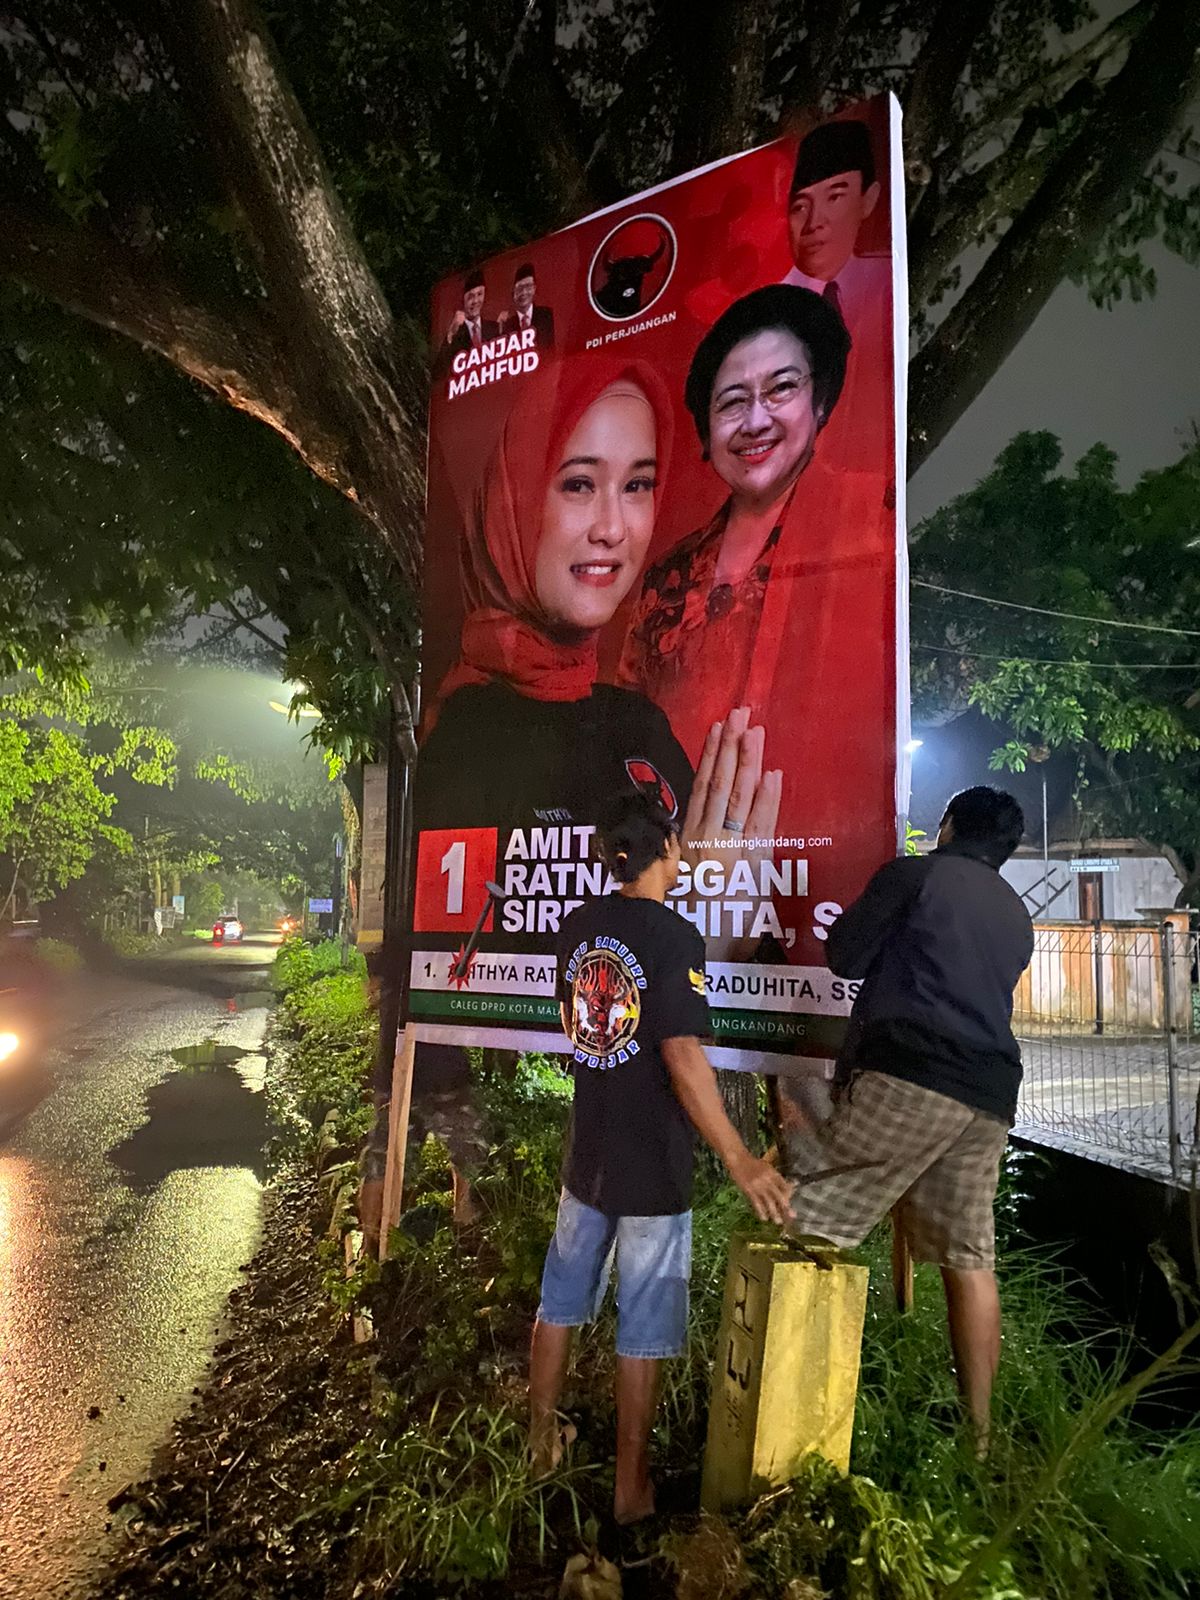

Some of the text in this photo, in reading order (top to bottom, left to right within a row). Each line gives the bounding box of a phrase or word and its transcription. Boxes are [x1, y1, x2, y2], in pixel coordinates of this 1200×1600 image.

[452, 327, 536, 374] GANJAR
[585, 311, 678, 350] PDI PERJUANGAN
[447, 352, 540, 400] MAHFUD
[688, 836, 832, 850] www.kedungkandang.com
[440, 842, 466, 914] 1
[664, 901, 796, 949] HITA,
[424, 962, 437, 978] 1.
[450, 1000, 478, 1011] CALEG
[481, 1001, 506, 1012] DPRD
[509, 1004, 534, 1014] KOTA
